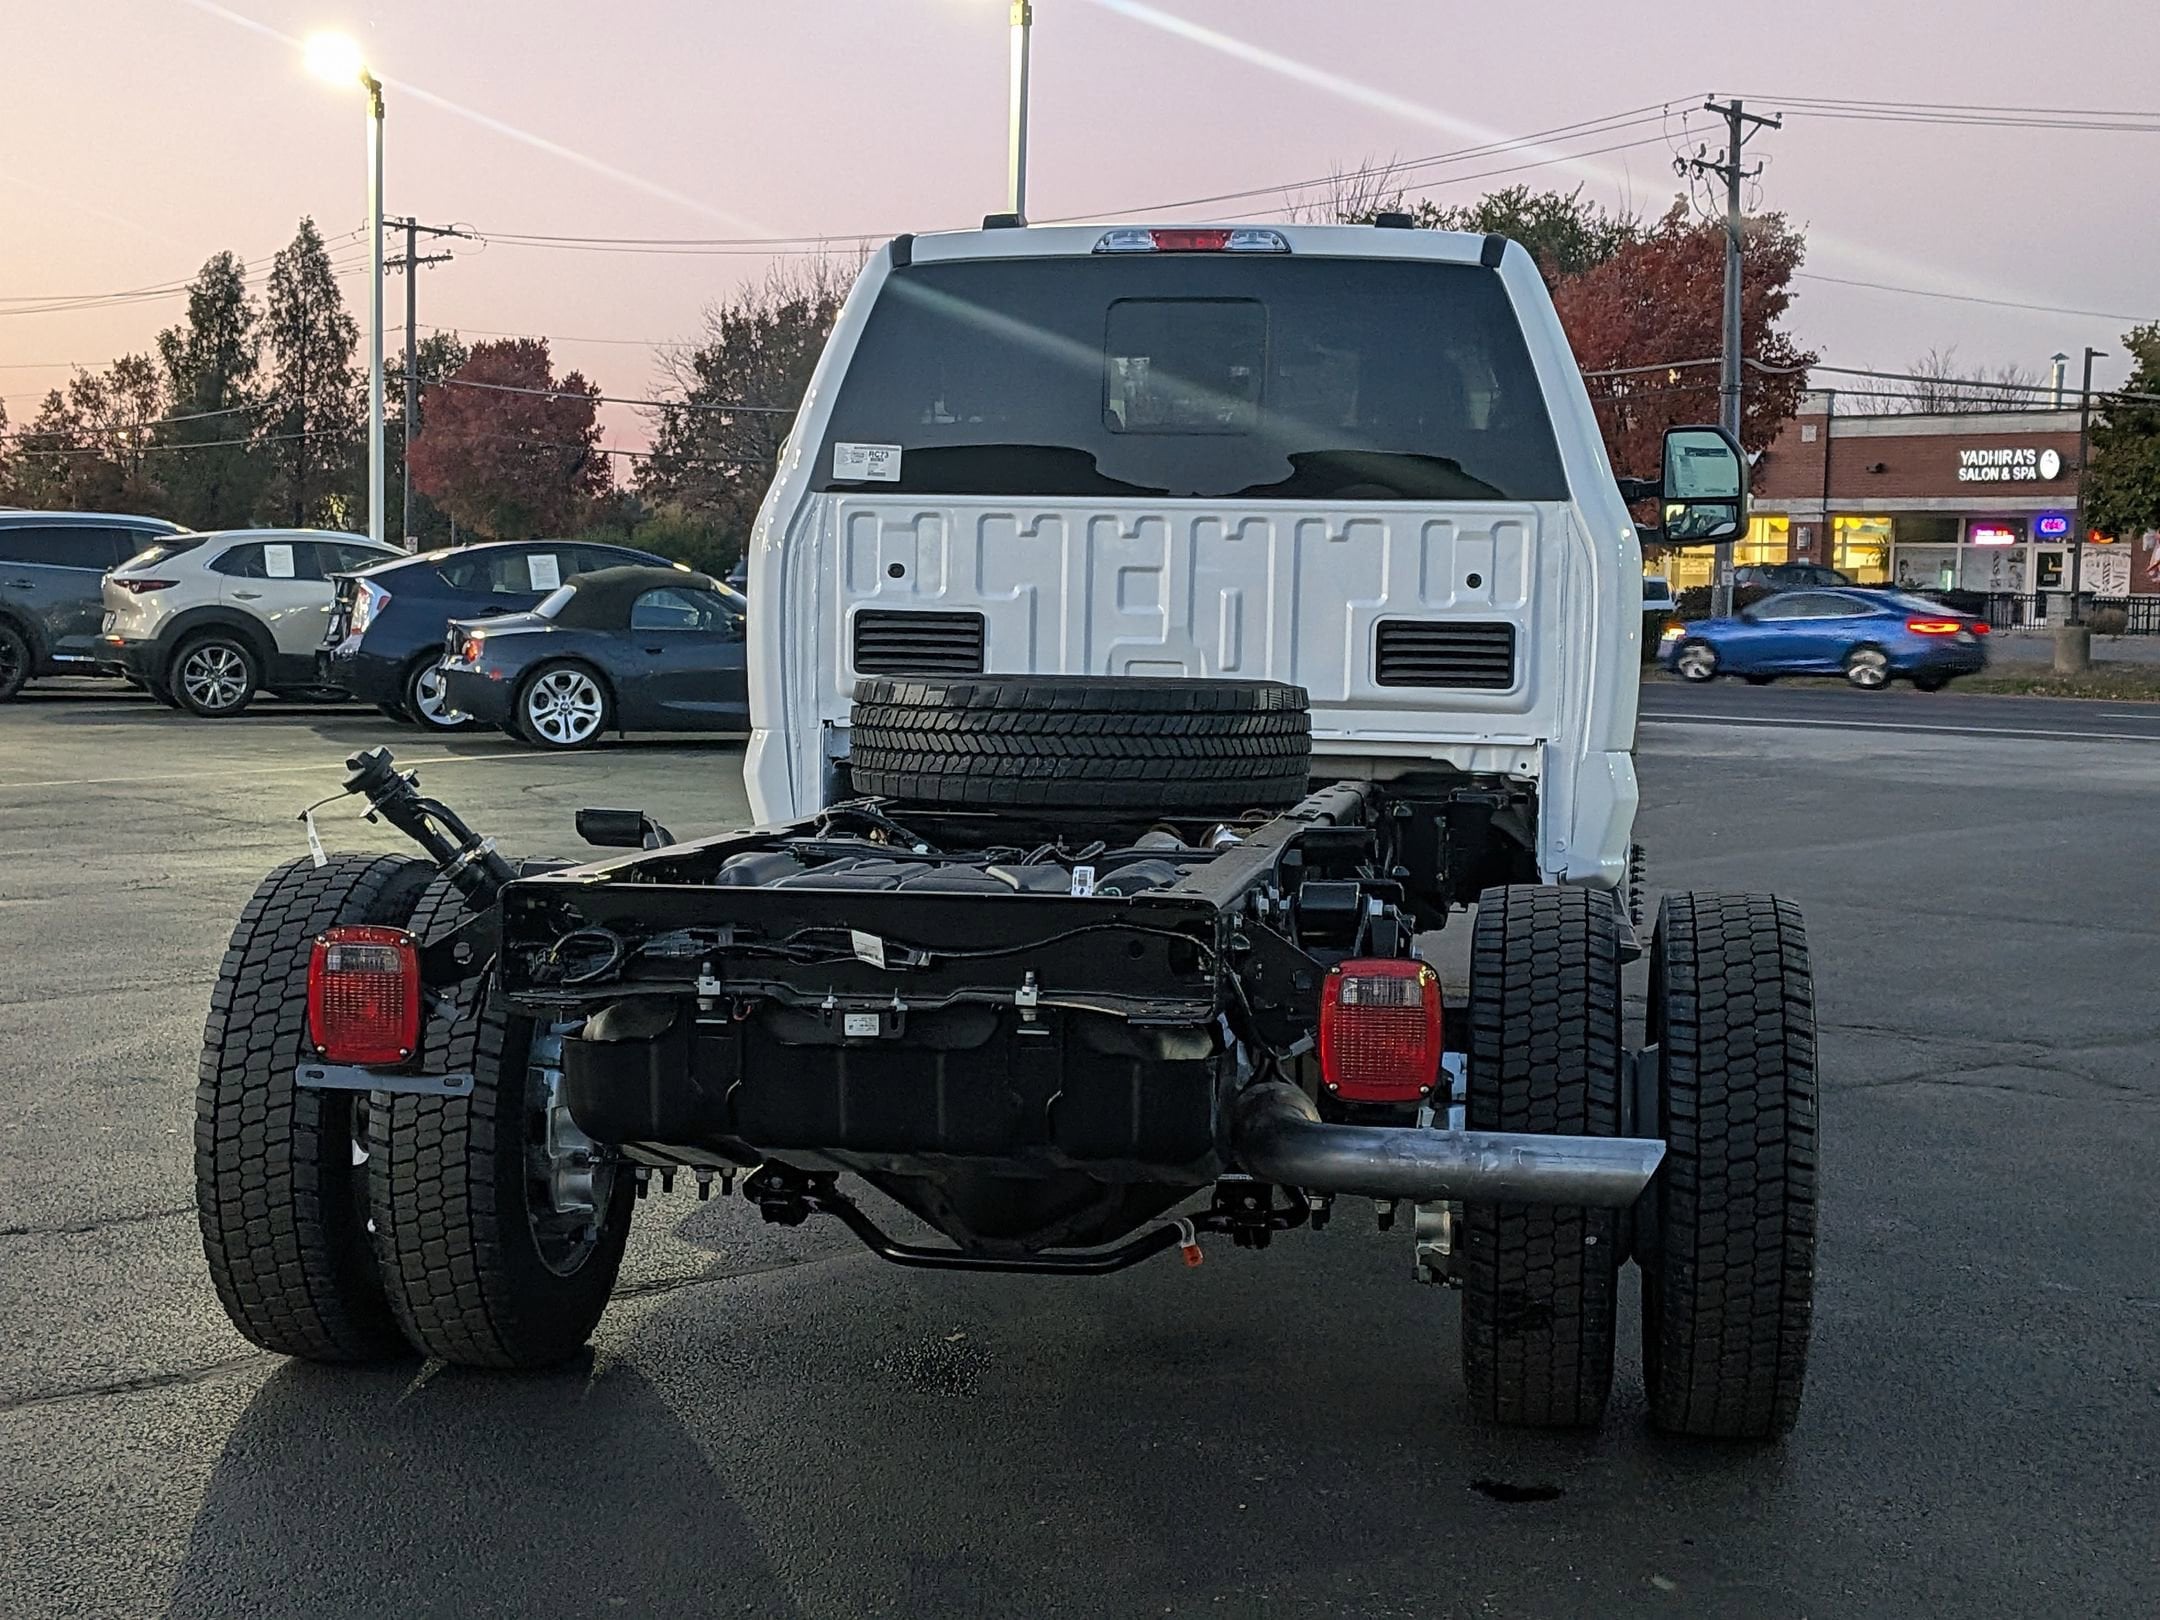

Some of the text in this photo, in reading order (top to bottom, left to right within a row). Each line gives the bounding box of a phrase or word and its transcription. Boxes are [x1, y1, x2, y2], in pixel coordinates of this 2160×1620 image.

[1960, 449, 2036, 465] YADHIRA'S
[1959, 466, 2036, 481] SALON & SPA
